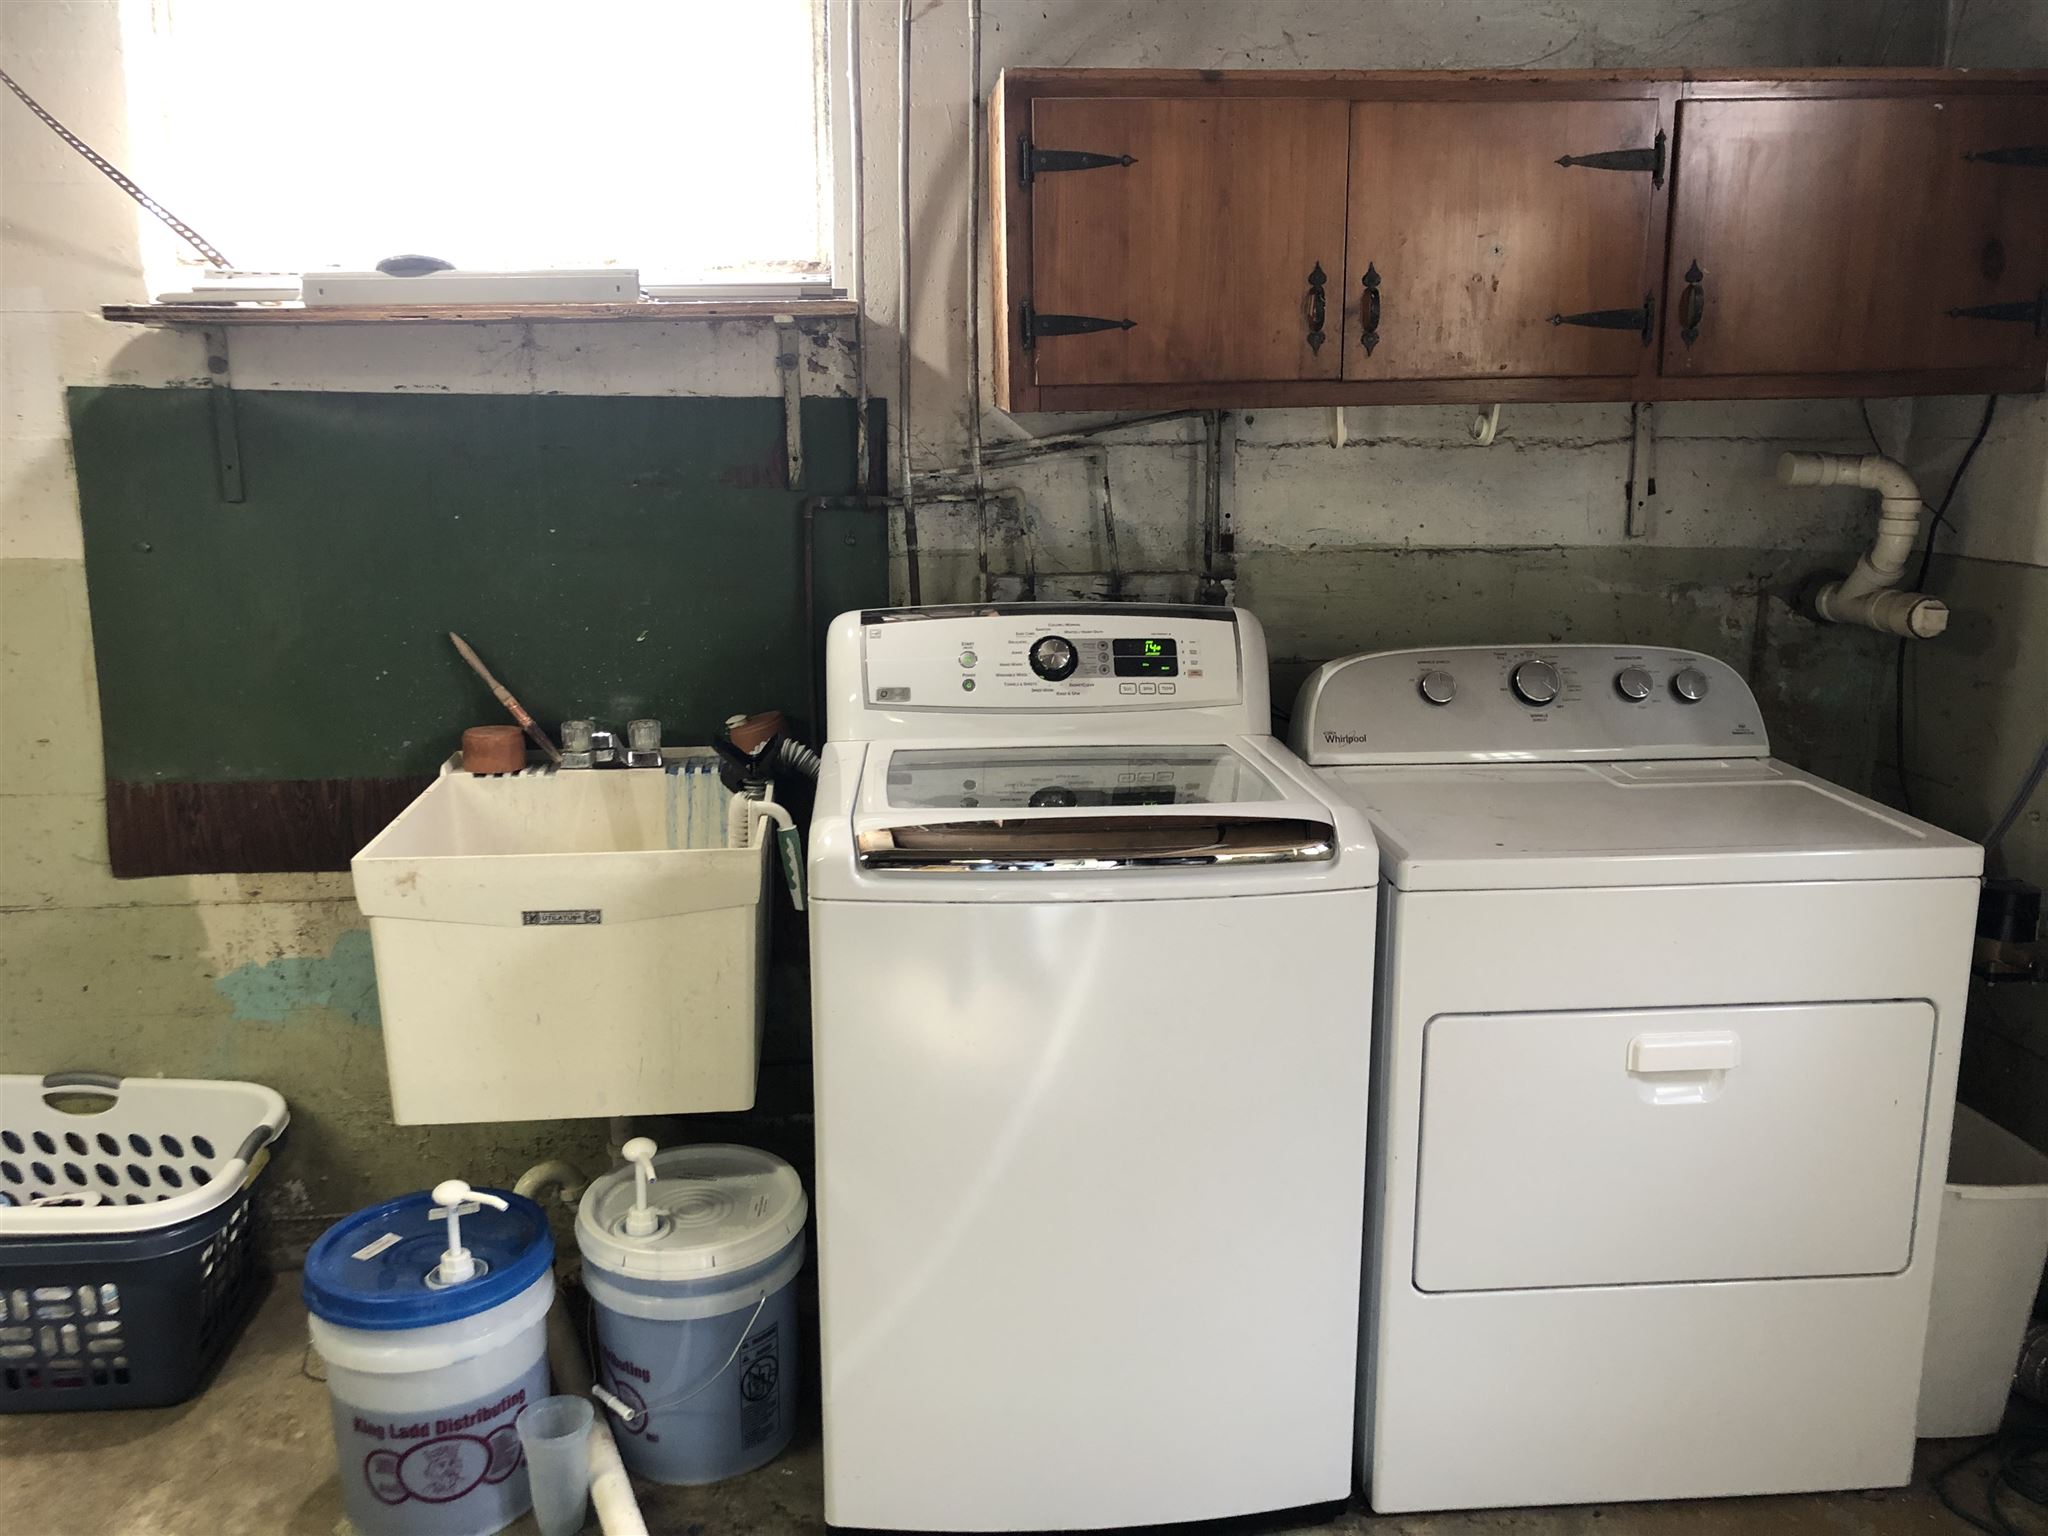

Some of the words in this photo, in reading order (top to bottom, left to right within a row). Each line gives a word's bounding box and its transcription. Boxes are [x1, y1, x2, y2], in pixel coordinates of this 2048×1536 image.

[1324, 734, 1368, 745] Whirlpool
[353, 1415, 386, 1440] King
[389, 1421, 431, 1440] Ladd
[435, 1387, 527, 1434] Distributing
